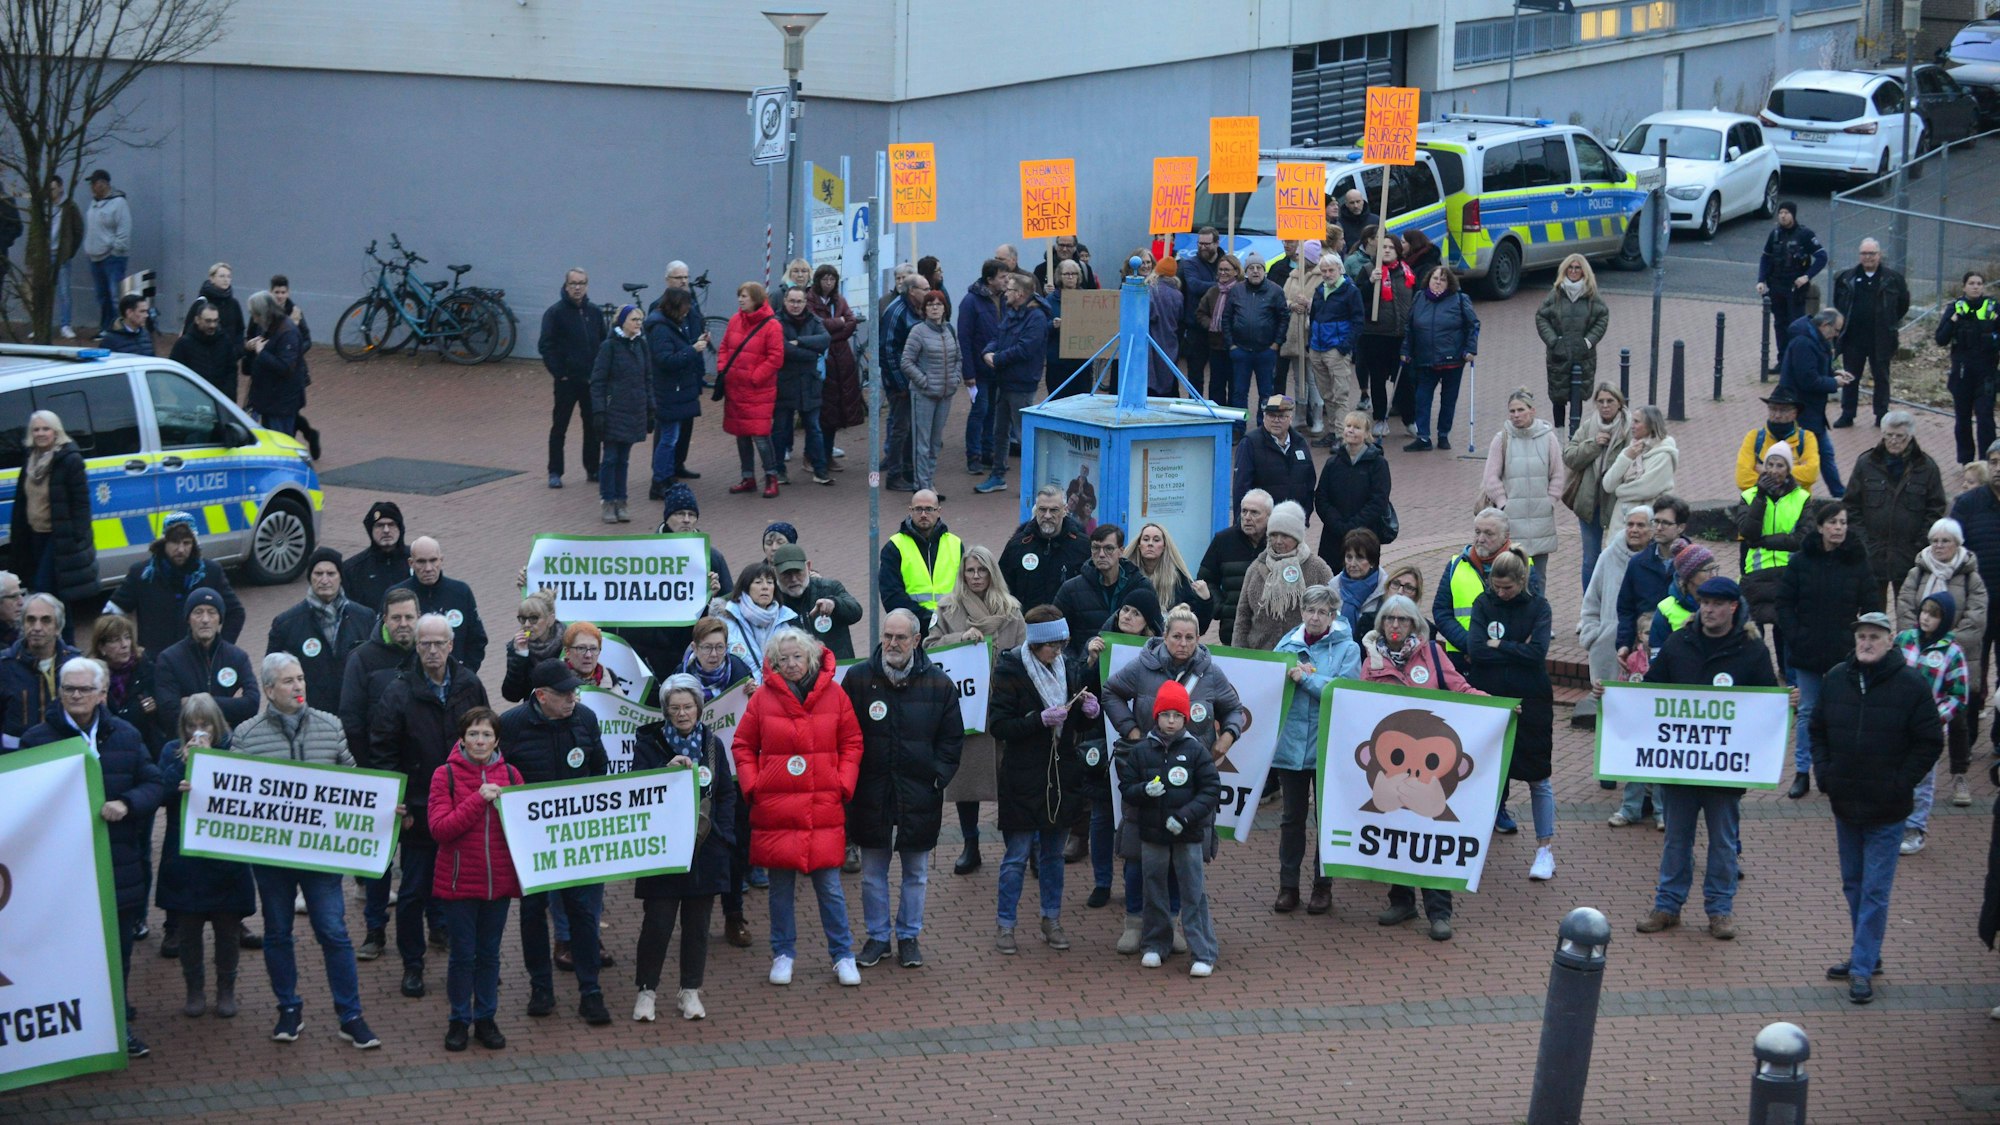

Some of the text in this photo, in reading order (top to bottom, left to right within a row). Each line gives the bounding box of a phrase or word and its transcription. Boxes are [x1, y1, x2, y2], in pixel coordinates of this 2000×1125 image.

[1370, 92, 1414, 109] NICHT
[765, 109, 778, 129] 30
[1370, 110, 1413, 127] MEINE
[761, 142, 778, 154] ZONE
[1215, 140, 1254, 153] NICHT
[1367, 143, 1410, 160] INITIATIVE
[1219, 154, 1253, 168] MEIN
[895, 170, 931, 186] NICHT
[1210, 171, 1257, 185] PROTEST
[1277, 166, 1325, 182] NICHT
[896, 186, 932, 200] MEIN
[1026, 186, 1069, 202] NICHT
[1156, 184, 1192, 207] OHNE
[1278, 187, 1319, 206] MEIN
[896, 200, 932, 216] PROTEST
[1026, 201, 1071, 217] MEIN
[1588, 197, 1614, 210] POLIZEI
[1026, 215, 1071, 231] PROTEST
[1154, 207, 1191, 229] MICH
[1277, 214, 1323, 230] PROTEST
[176, 471, 228, 494] POLIZEI
[543, 552, 690, 575] KÖNIGSDORF
[538, 581, 694, 601] WILL DIALOG!
[1654, 697, 1736, 720] DIALOG
[1657, 723, 1732, 745] STATT
[1635, 747, 1750, 772] MONOLOG!
[212, 771, 378, 809] WIR SIND KEINE
[527, 785, 667, 821] SCHLUSS MIT
[206, 795, 375, 833] MELKKÜHE, WIR
[546, 812, 651, 844] TAUBHEIT
[195, 818, 379, 858] FORDERN DIALOG!
[1358, 824, 1480, 867] STUPP
[533, 835, 667, 872] IM RATHAUS!
